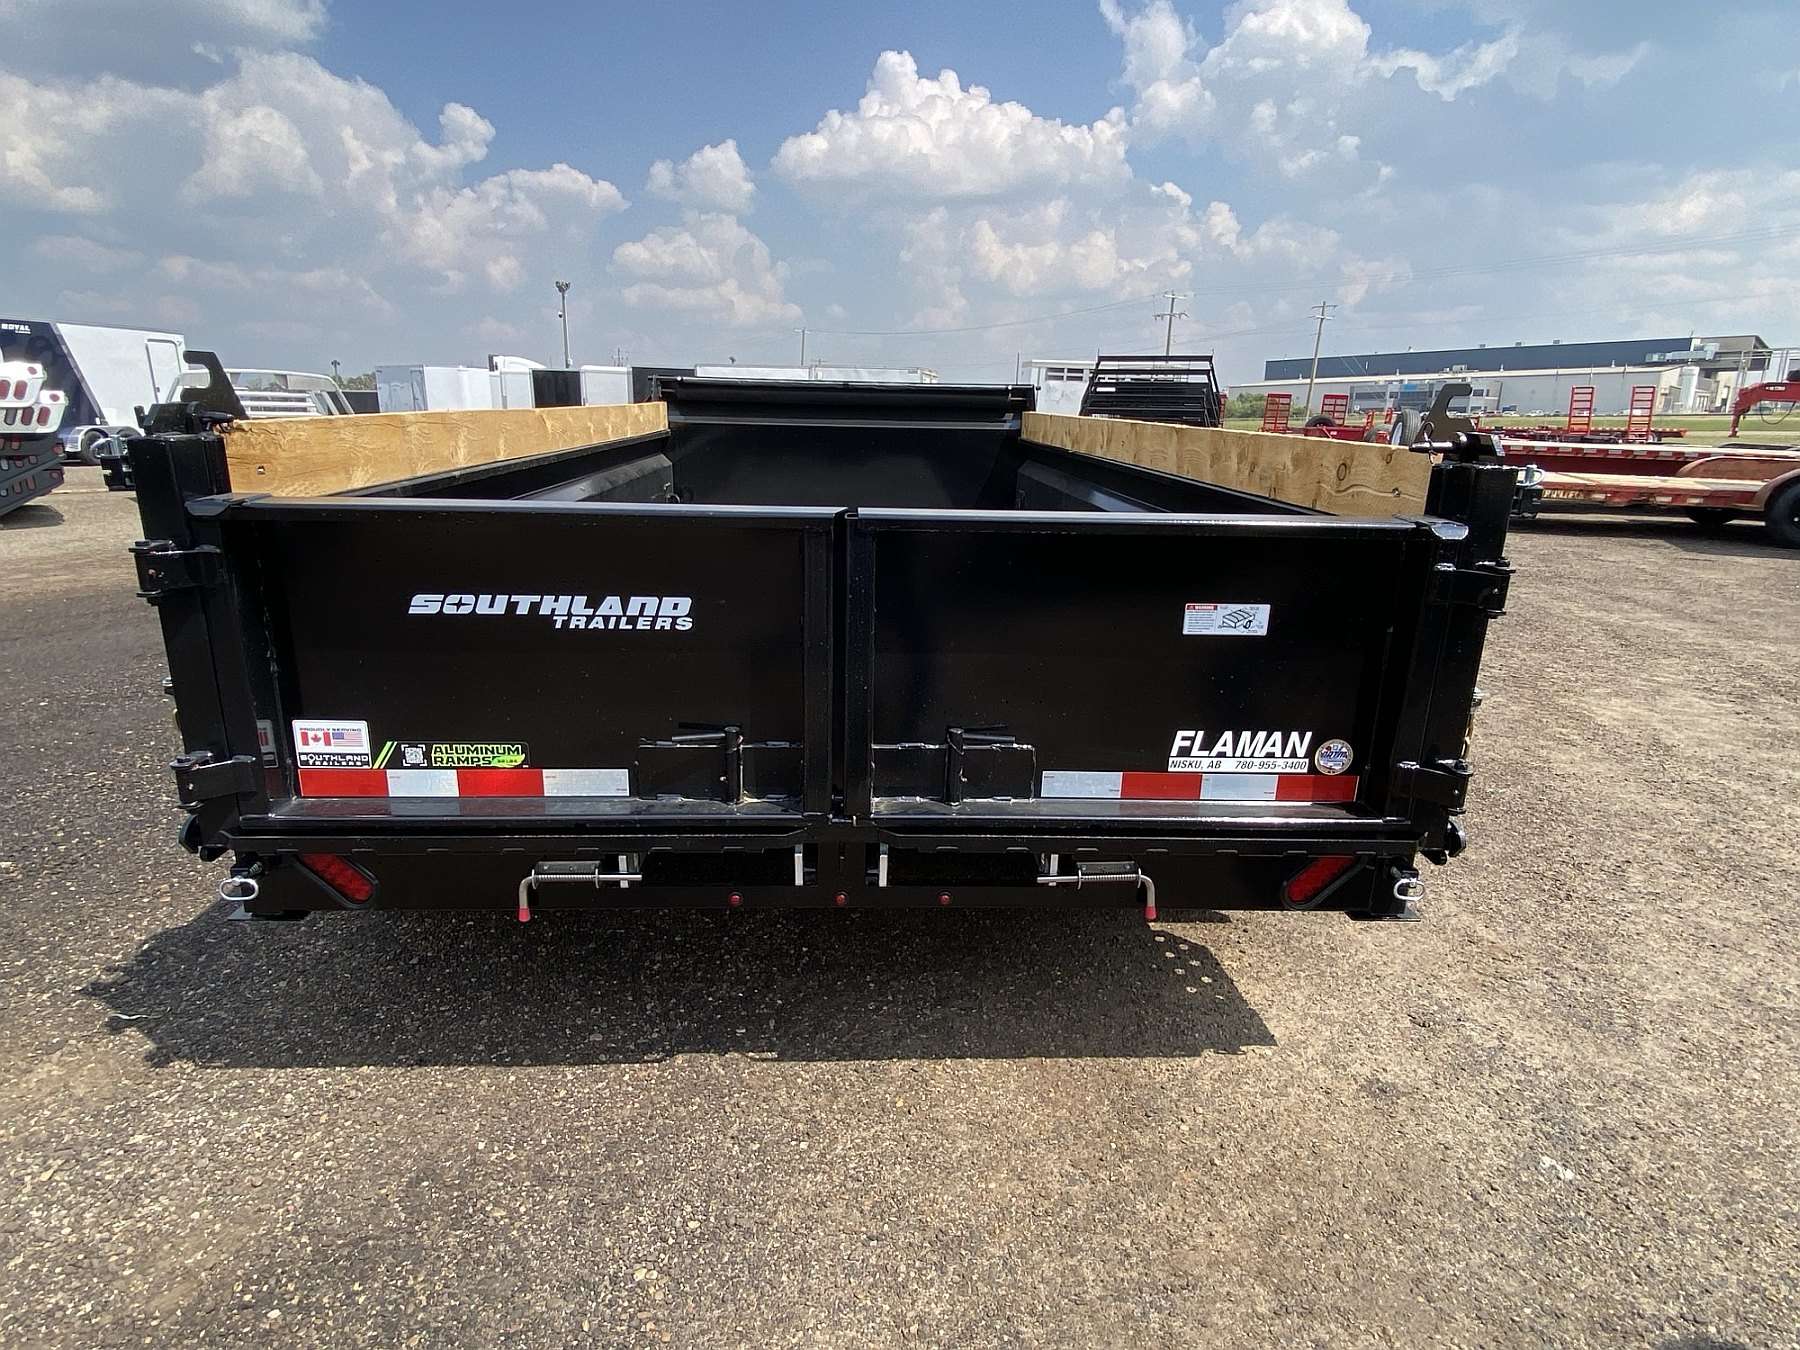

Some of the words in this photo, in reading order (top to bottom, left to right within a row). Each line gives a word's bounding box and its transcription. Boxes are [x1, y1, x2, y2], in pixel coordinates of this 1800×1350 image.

[408, 594, 693, 616] SOUTHLAND
[552, 616, 693, 630] TRAILERS
[1170, 730, 1312, 758] FLAMAN
[433, 745, 522, 755] ALUMINUM
[300, 753, 369, 762] SOUTHLAND
[433, 755, 493, 766] RAMPS
[1169, 760, 1203, 770] NISKU,
[1207, 760, 1222, 769] AB
[1234, 760, 1307, 770] 780-955-3400
